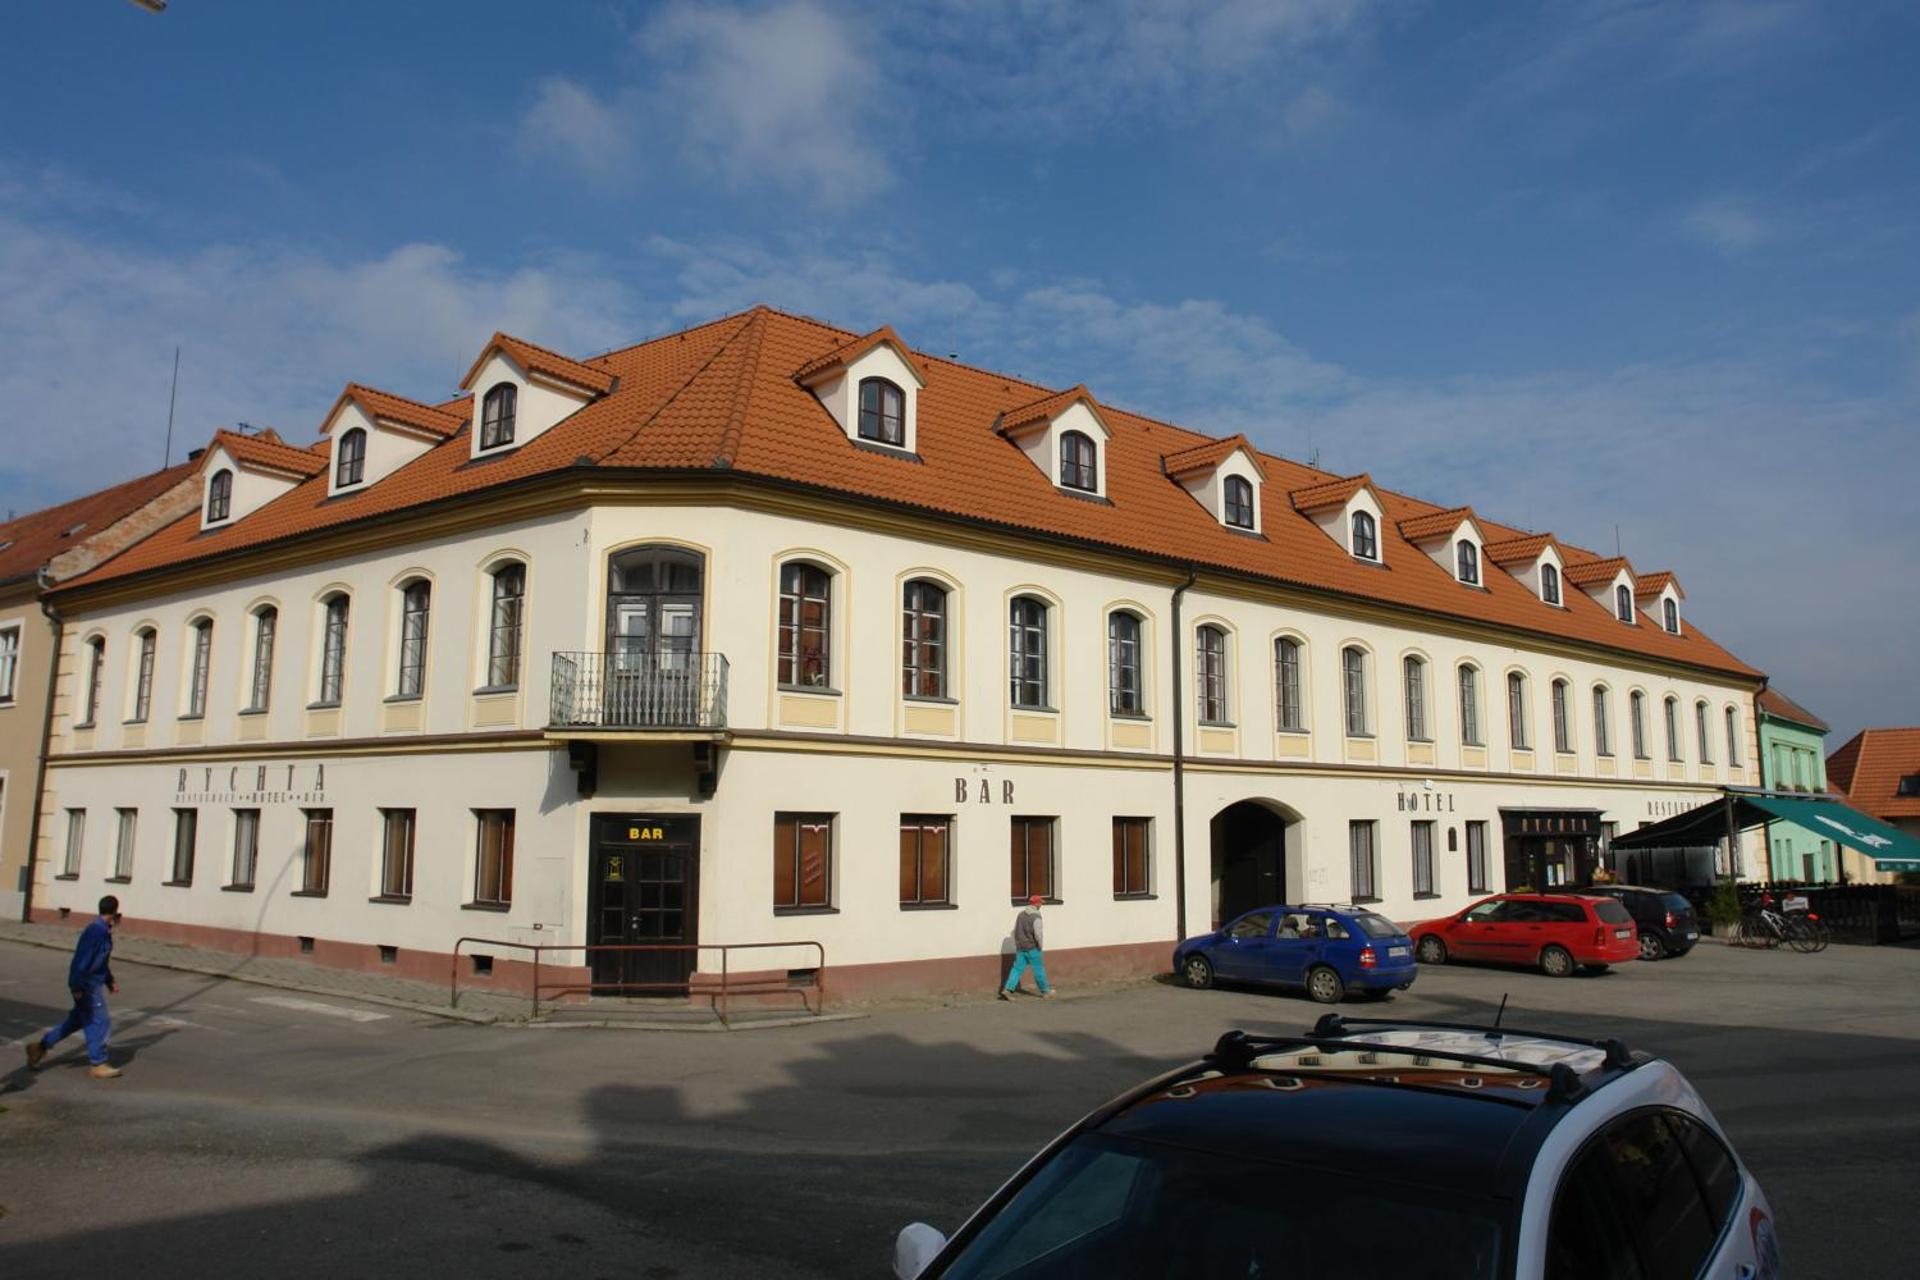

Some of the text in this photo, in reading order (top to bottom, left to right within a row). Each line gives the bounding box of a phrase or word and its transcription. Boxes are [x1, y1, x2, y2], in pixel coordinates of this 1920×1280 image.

[177, 764, 325, 792] RYCHTA
[955, 777, 1014, 804] BAR
[1397, 792, 1455, 812] HOTEL
[629, 828, 663, 840] BAR
